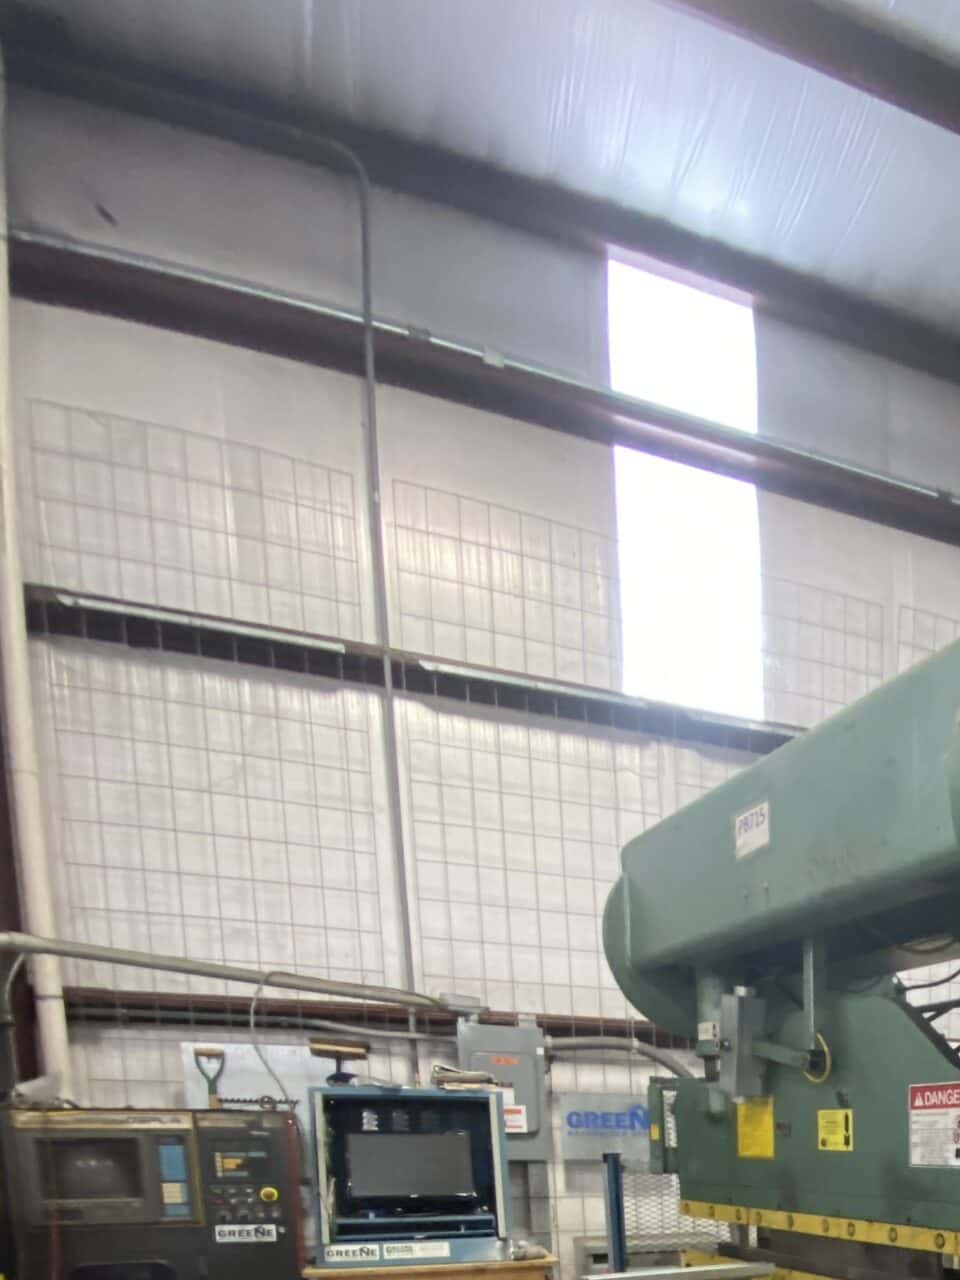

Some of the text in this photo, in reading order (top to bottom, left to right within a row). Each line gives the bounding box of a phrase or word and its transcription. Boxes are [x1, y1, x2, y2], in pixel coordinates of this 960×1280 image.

[566, 1105, 648, 1130] GREEN
[218, 1226, 273, 1238] GREENE
[326, 1247, 378, 1257] GREENE
